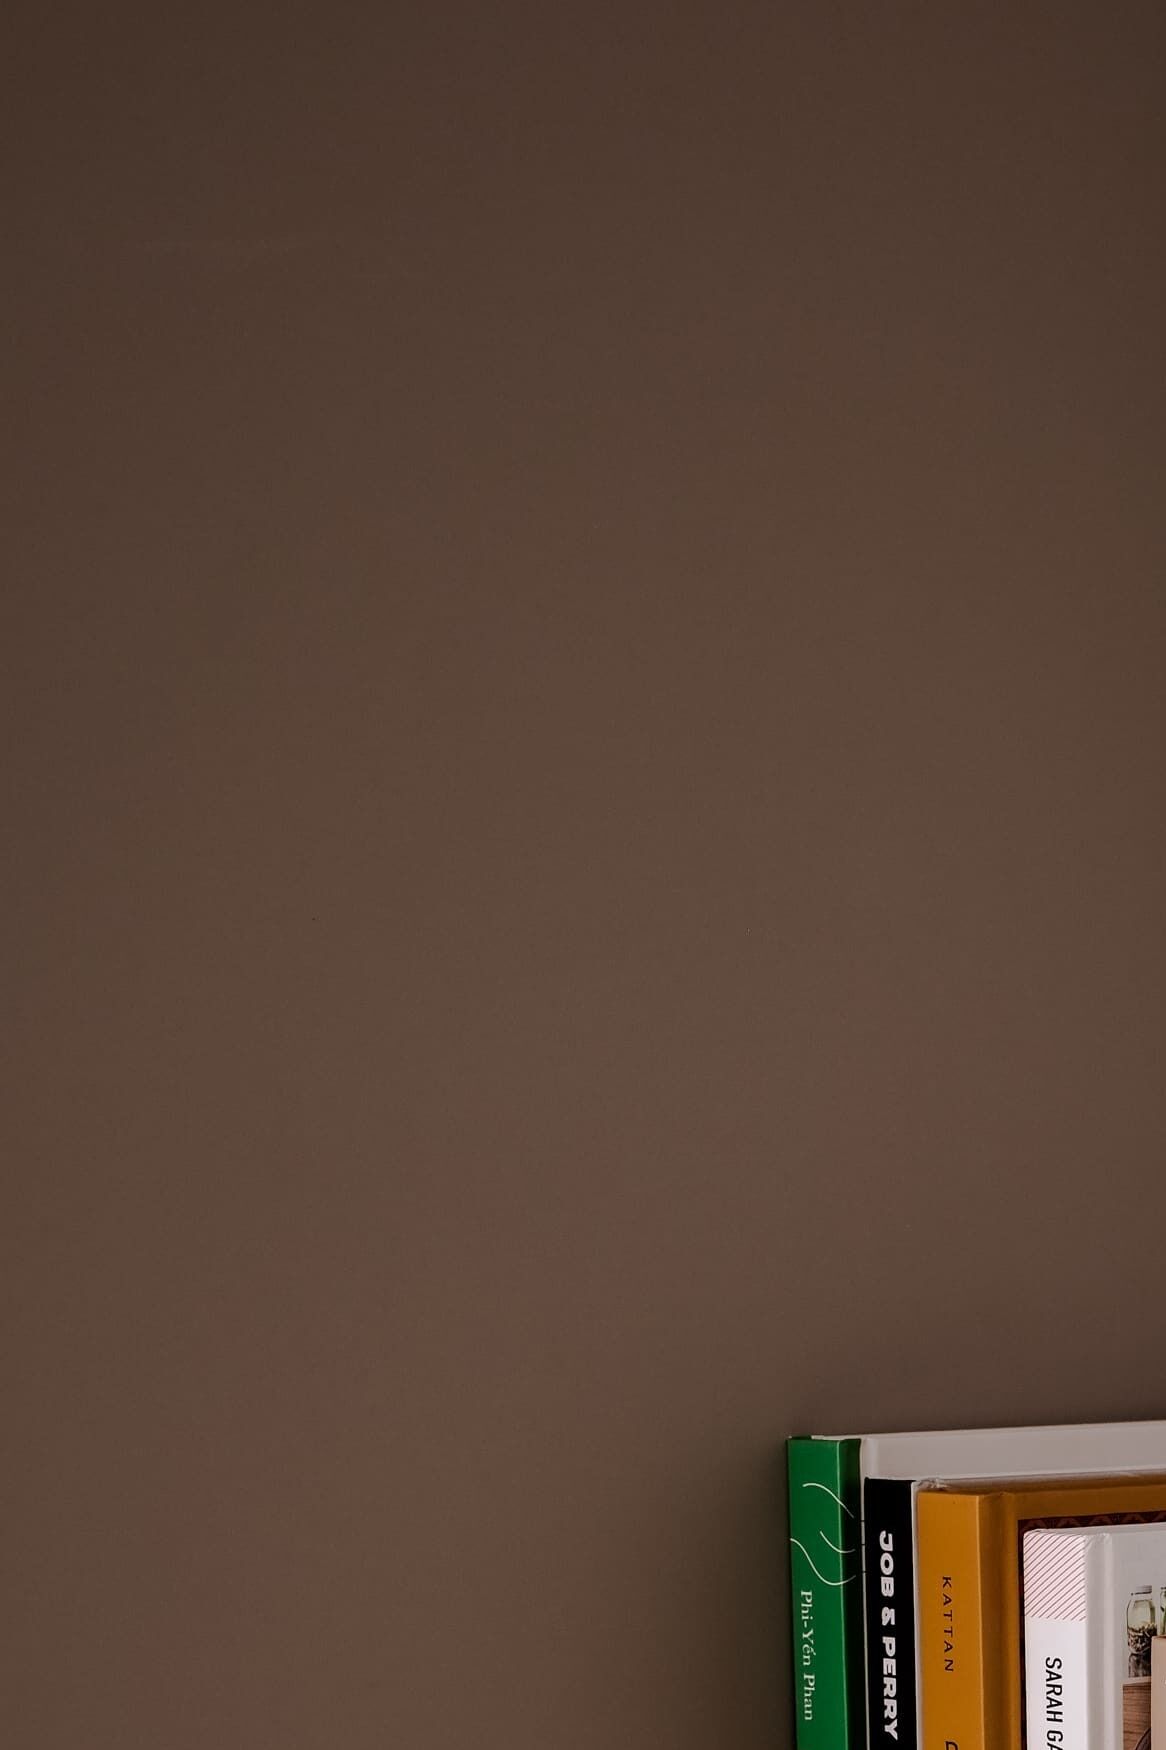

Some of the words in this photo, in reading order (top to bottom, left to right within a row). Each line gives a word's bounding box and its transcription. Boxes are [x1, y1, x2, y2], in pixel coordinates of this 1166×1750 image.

[879, 1530, 895, 1598] JOB
[881, 1606, 896, 1626] &
[942, 1576, 954, 1672] KATTAN
[803, 1673, 816, 1721] Phan
[882, 1636, 898, 1741] PERRY
[1045, 1656, 1063, 1723] SARAH
